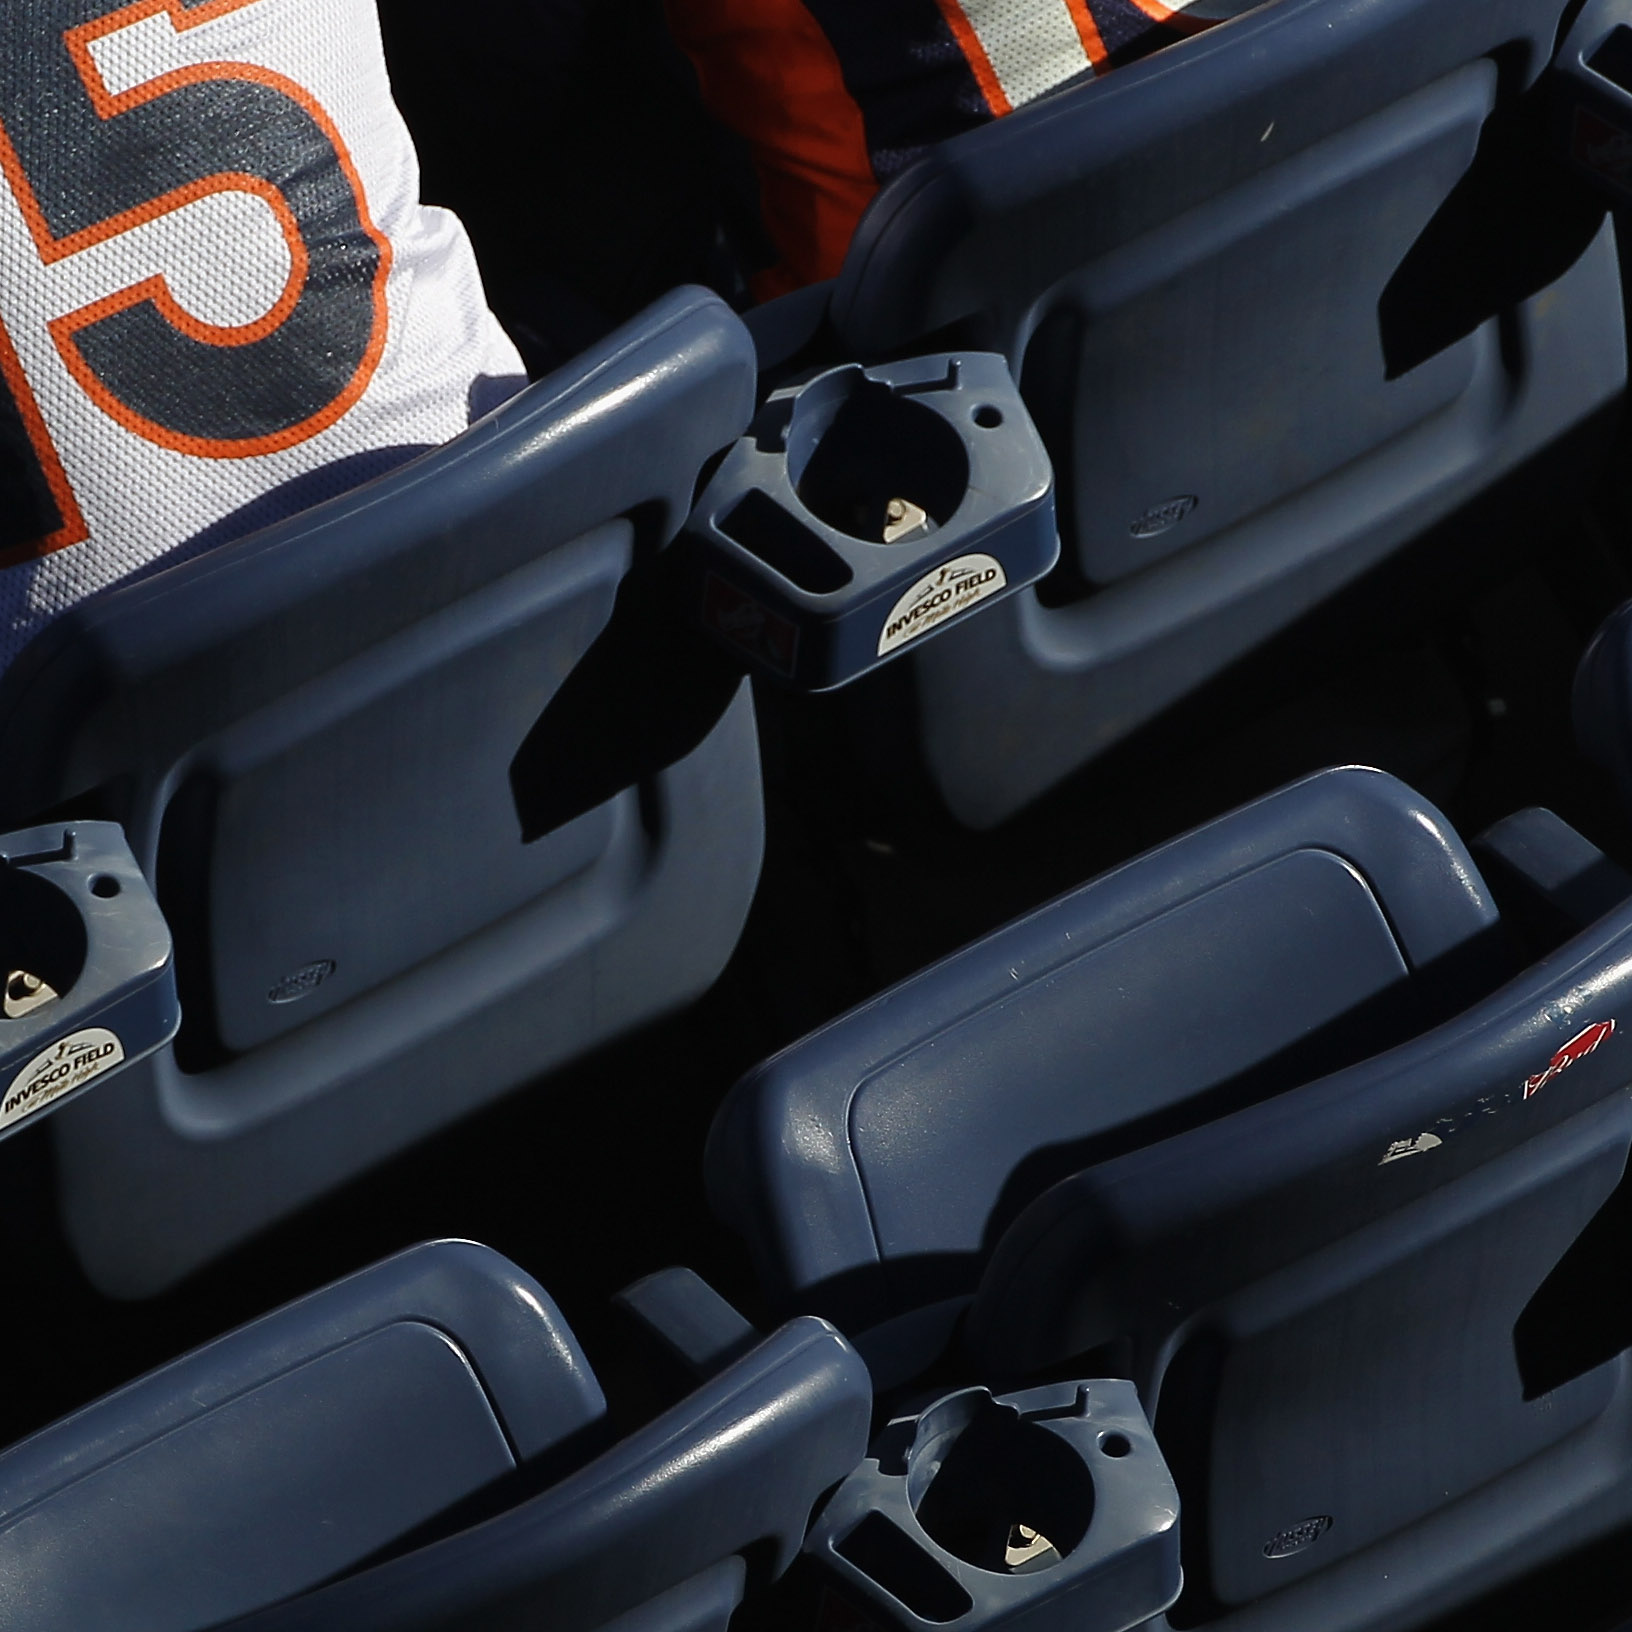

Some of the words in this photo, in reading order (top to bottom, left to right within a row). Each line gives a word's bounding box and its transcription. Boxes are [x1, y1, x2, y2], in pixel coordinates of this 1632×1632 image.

[886, 588, 953, 640] INVESCO
[954, 568, 997, 596] FIELD
[4, 1063, 71, 1115] INVESCO
[73, 1042, 115, 1071] FIELD
